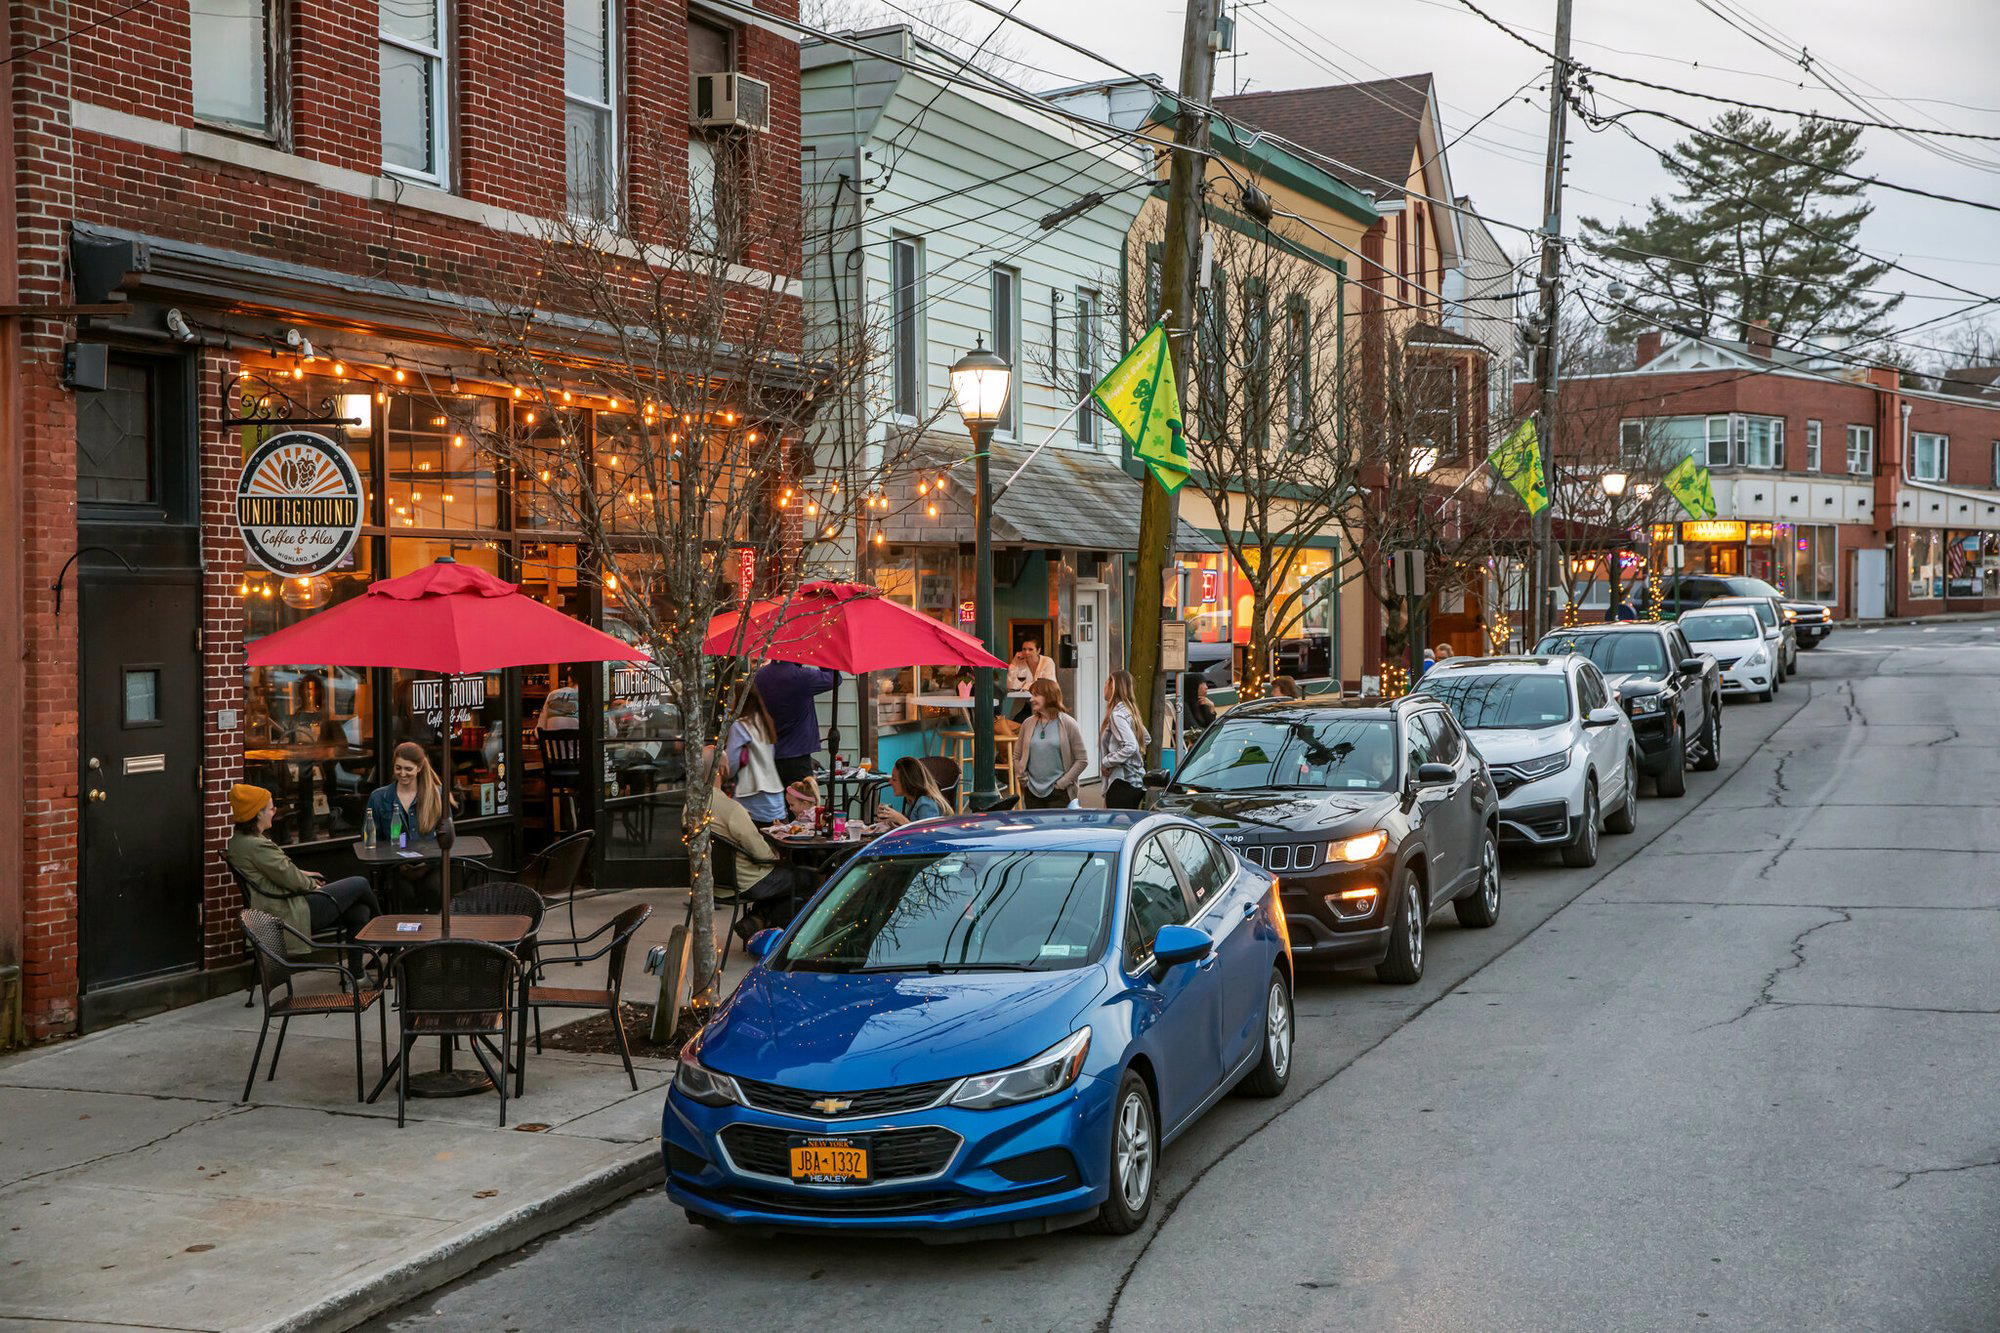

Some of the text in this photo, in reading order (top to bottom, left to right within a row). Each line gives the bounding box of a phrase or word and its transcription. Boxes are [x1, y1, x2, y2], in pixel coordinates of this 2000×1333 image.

[241, 499, 354, 525] UNDERGROUND
[261, 529, 334, 547] Coffee & Ales
[412, 680, 484, 710] UNDEROUND
[427, 711, 443, 728] Coff
[1224, 834, 1244, 842] Jeep
